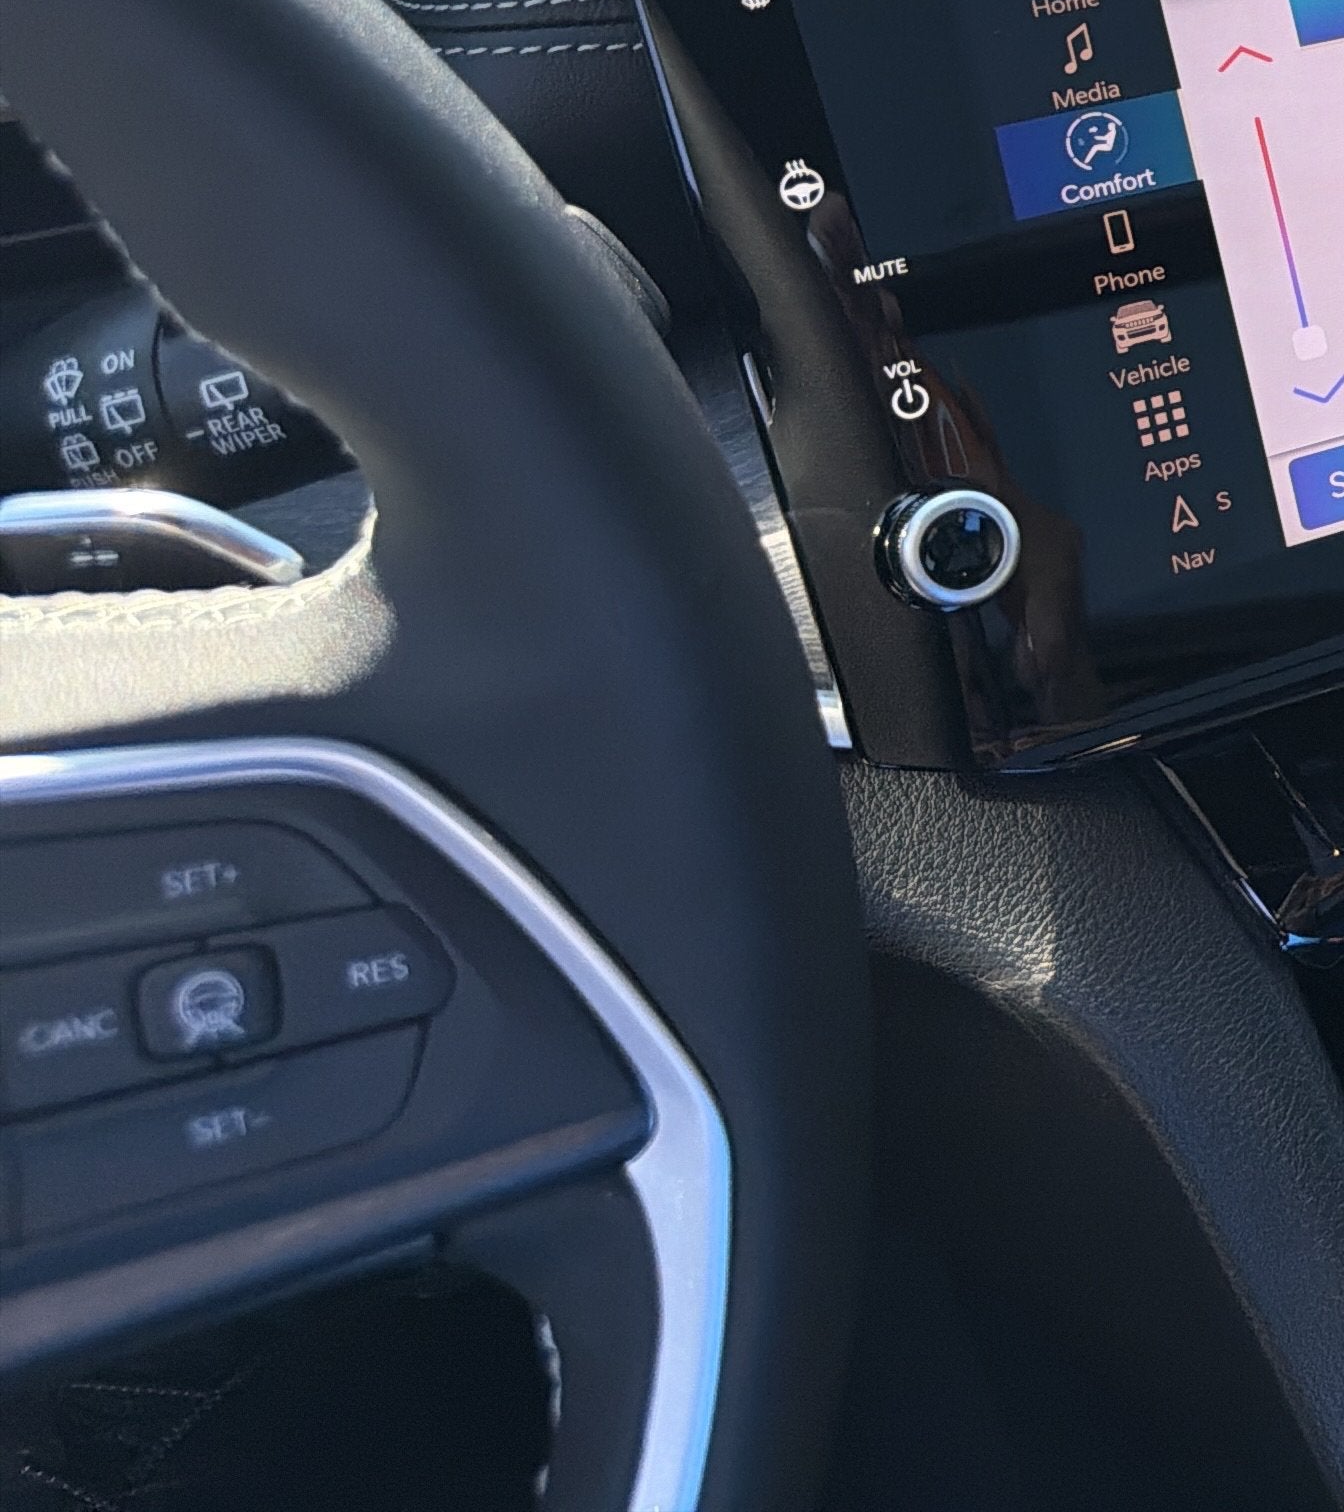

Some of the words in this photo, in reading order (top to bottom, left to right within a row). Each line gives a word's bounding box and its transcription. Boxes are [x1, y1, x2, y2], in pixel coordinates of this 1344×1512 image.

[1052, 79, 1121, 111] Media
[1060, 168, 1157, 205] Comfort
[853, 257, 910, 286] MUTE
[1093, 261, 1166, 295] Phone
[102, 349, 136, 376] ON
[883, 358, 922, 381] VOL
[1109, 354, 1191, 388] Vehicle
[48, 404, 94, 430] PULL
[207, 406, 270, 438] REAR
[211, 423, 288, 456] WIPER
[115, 441, 160, 470] OFF
[1144, 452, 1202, 482] Apps
[1216, 491, 1232, 512] S
[1171, 547, 1216, 574] Nav
[346, 952, 411, 990] RES
